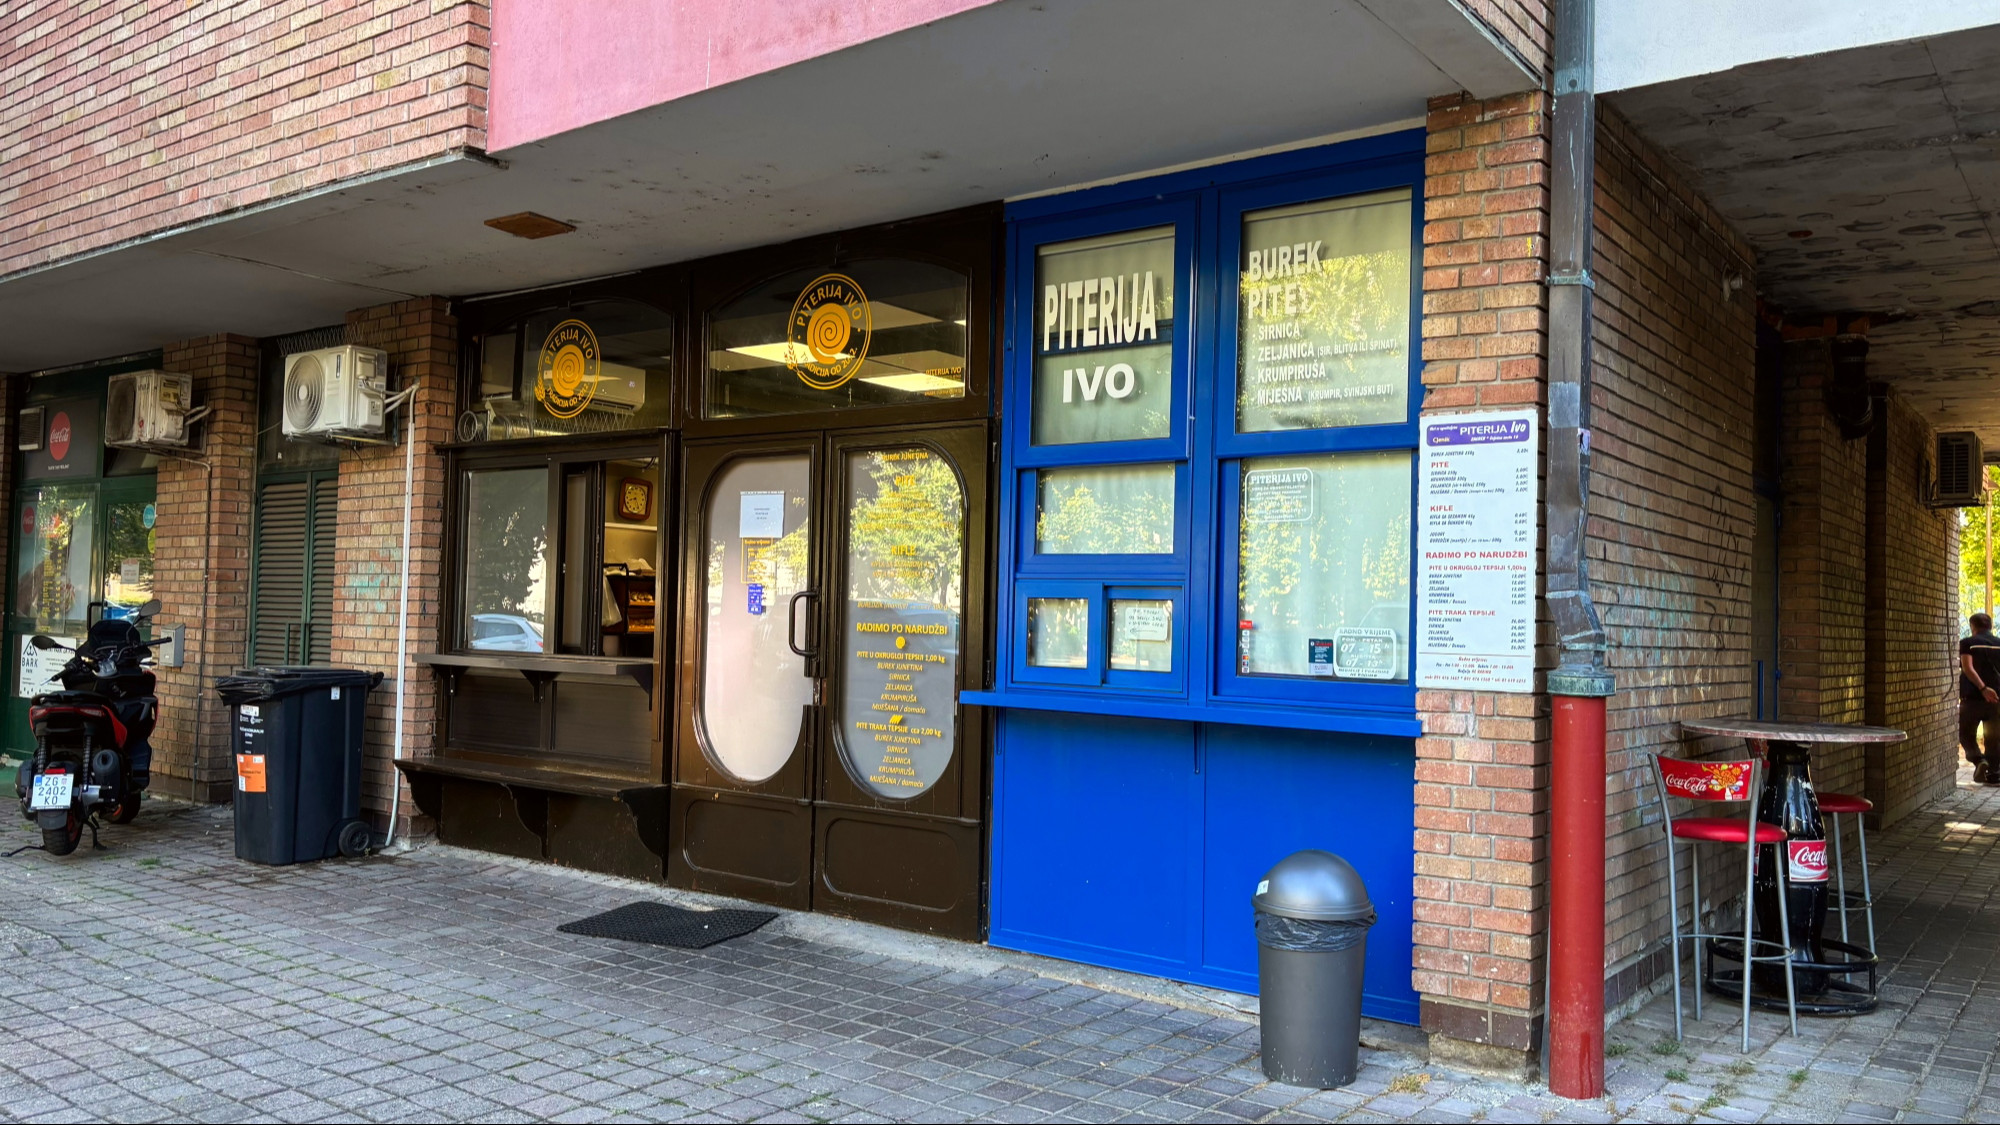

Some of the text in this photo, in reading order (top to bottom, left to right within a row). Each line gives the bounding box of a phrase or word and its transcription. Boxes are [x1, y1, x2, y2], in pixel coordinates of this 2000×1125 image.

[1249, 240, 1322, 282] BUREK
[796, 284, 862, 327] PITERIJA IVO
[1044, 271, 1157, 351] PITERIJA
[1258, 322, 1300, 340] SIRNICA
[544, 328, 593, 365] PITERIJA IVO
[1258, 342, 1314, 362] ZELJANICA
[1317, 346, 1332, 358] (SIR,
[1334, 342, 1358, 354] BLITVA
[1360, 341, 1368, 352] ILI
[800, 352, 829, 377] TRADICIJA
[830, 364, 841, 376] OD
[1258, 360, 1326, 383] KRUMPIRUŠA
[1063, 363, 1134, 402] IVO
[1308, 388, 1342, 402] (KRUMPIR,
[1344, 386, 1374, 399] SVINJSKI
[1376, 384, 1394, 395] BUT)
[569, 396, 578, 407] OD
[50, 427, 69, 443] Coca-Cola
[1460, 424, 1507, 435] PITERIJA
[895, 475, 915, 486] PITE
[1251, 473, 1308, 484] PITERIJA IVO
[891, 546, 916, 556] KIFLE
[856, 622, 948, 635] RADIMO PO NARUDŽBI
[1341, 643, 1356, 653] 07
[1370, 643, 1381, 654] 15
[22, 657, 38, 668] BARK
[938, 655, 946, 664] kg
[1346, 659, 1358, 668] 07
[896, 663, 923, 672] JUNETINA
[889, 673, 910, 681] SIRNICA
[885, 683, 913, 691] ZELJANICA
[881, 693, 917, 702] KRUMPIRUŠA
[872, 703, 898, 712] MIJEŠANA
[869, 723, 886, 731] TRAKA
[888, 724, 908, 733] TEPSIJE
[921, 728, 933, 736] 2,00
[934, 729, 942, 738] kg
[894, 735, 921, 745] JUNETINA
[886, 746, 908, 754] SIRNICA
[882, 755, 911, 765] ZELJANICA
[879, 766, 915, 776] KRUMPIRUŠA
[45, 777, 58, 786] ZG
[870, 775, 896, 785] MIJEŠANA
[1666, 774, 1710, 795] Coca-Cola
[38, 786, 66, 796] 2402
